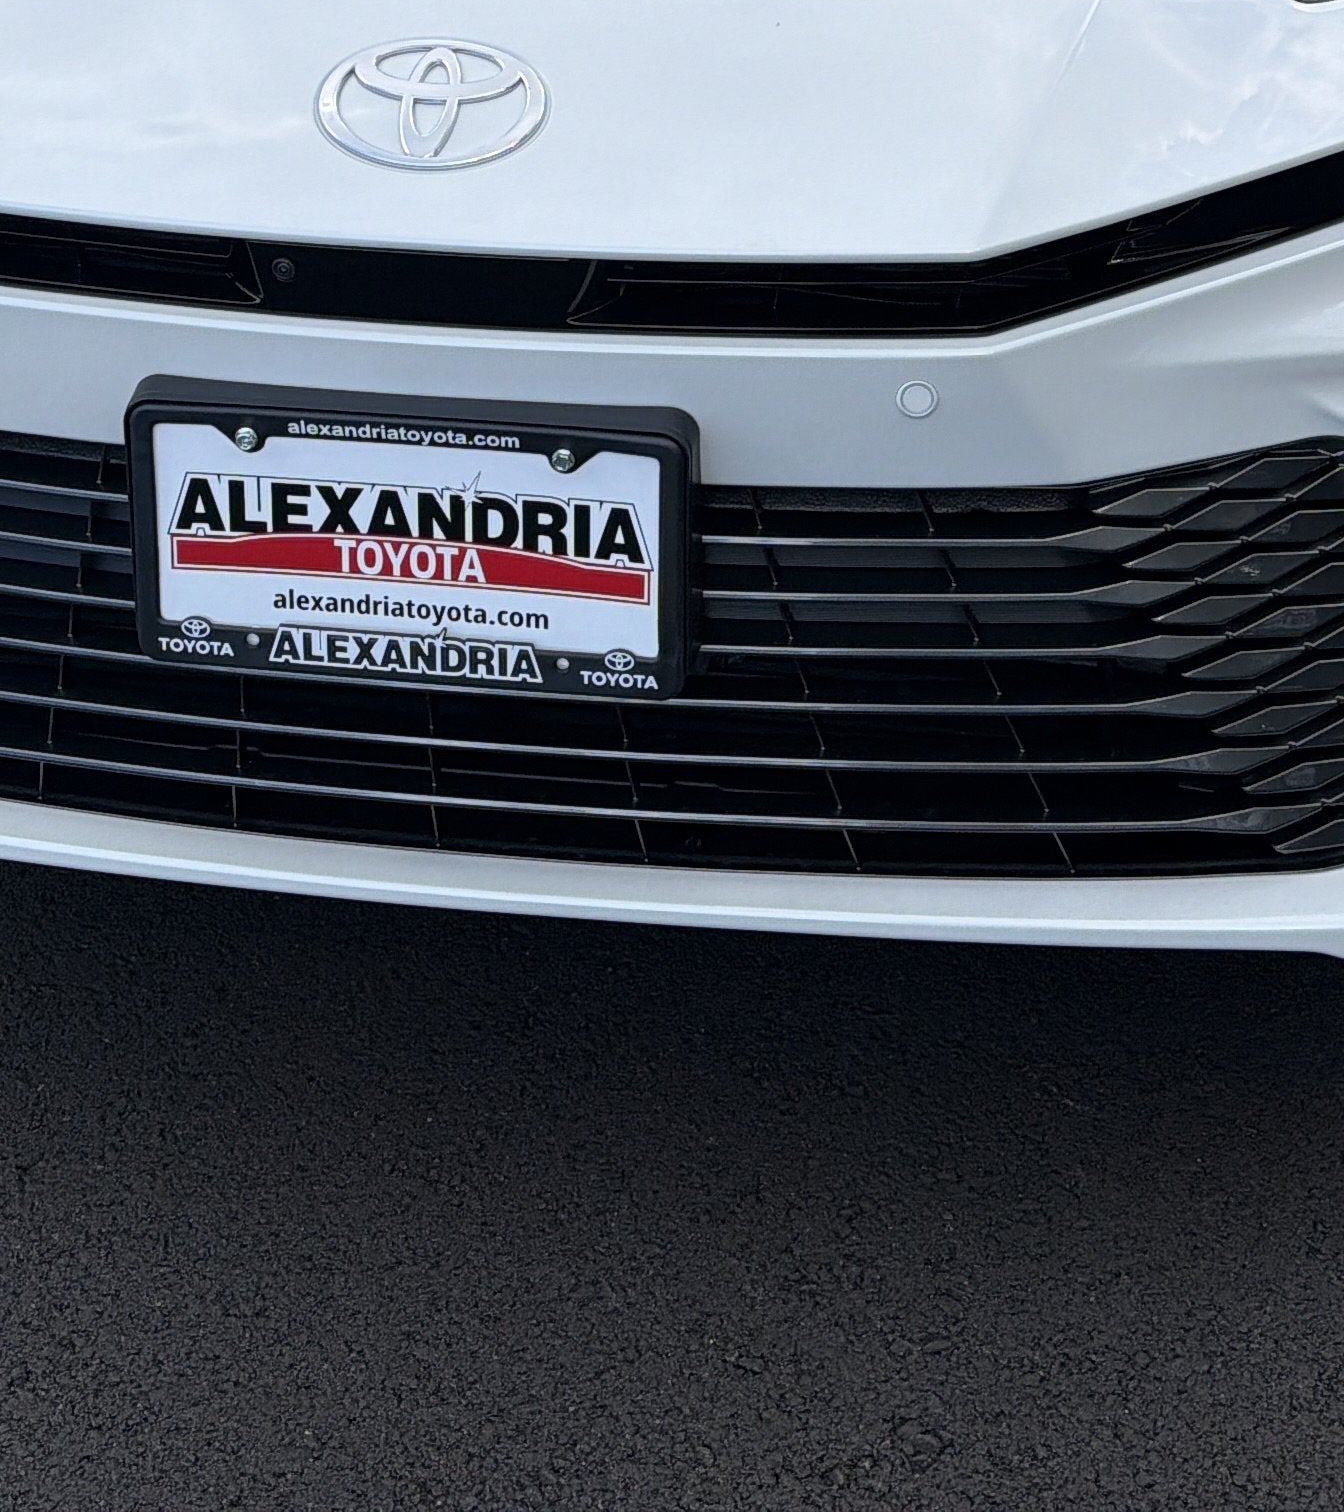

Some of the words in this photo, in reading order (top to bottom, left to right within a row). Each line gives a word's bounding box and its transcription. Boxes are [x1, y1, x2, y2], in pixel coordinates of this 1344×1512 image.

[287, 419, 520, 449] alexandriatoyota.com
[172, 475, 648, 566] ALEXANDRIA
[333, 538, 487, 583] TOYOTA
[273, 588, 549, 630] alexandriatoyota.com
[157, 637, 235, 657] TOYOTA
[270, 627, 543, 683] ALEXANDRIA
[580, 670, 659, 690] TOYOTA
